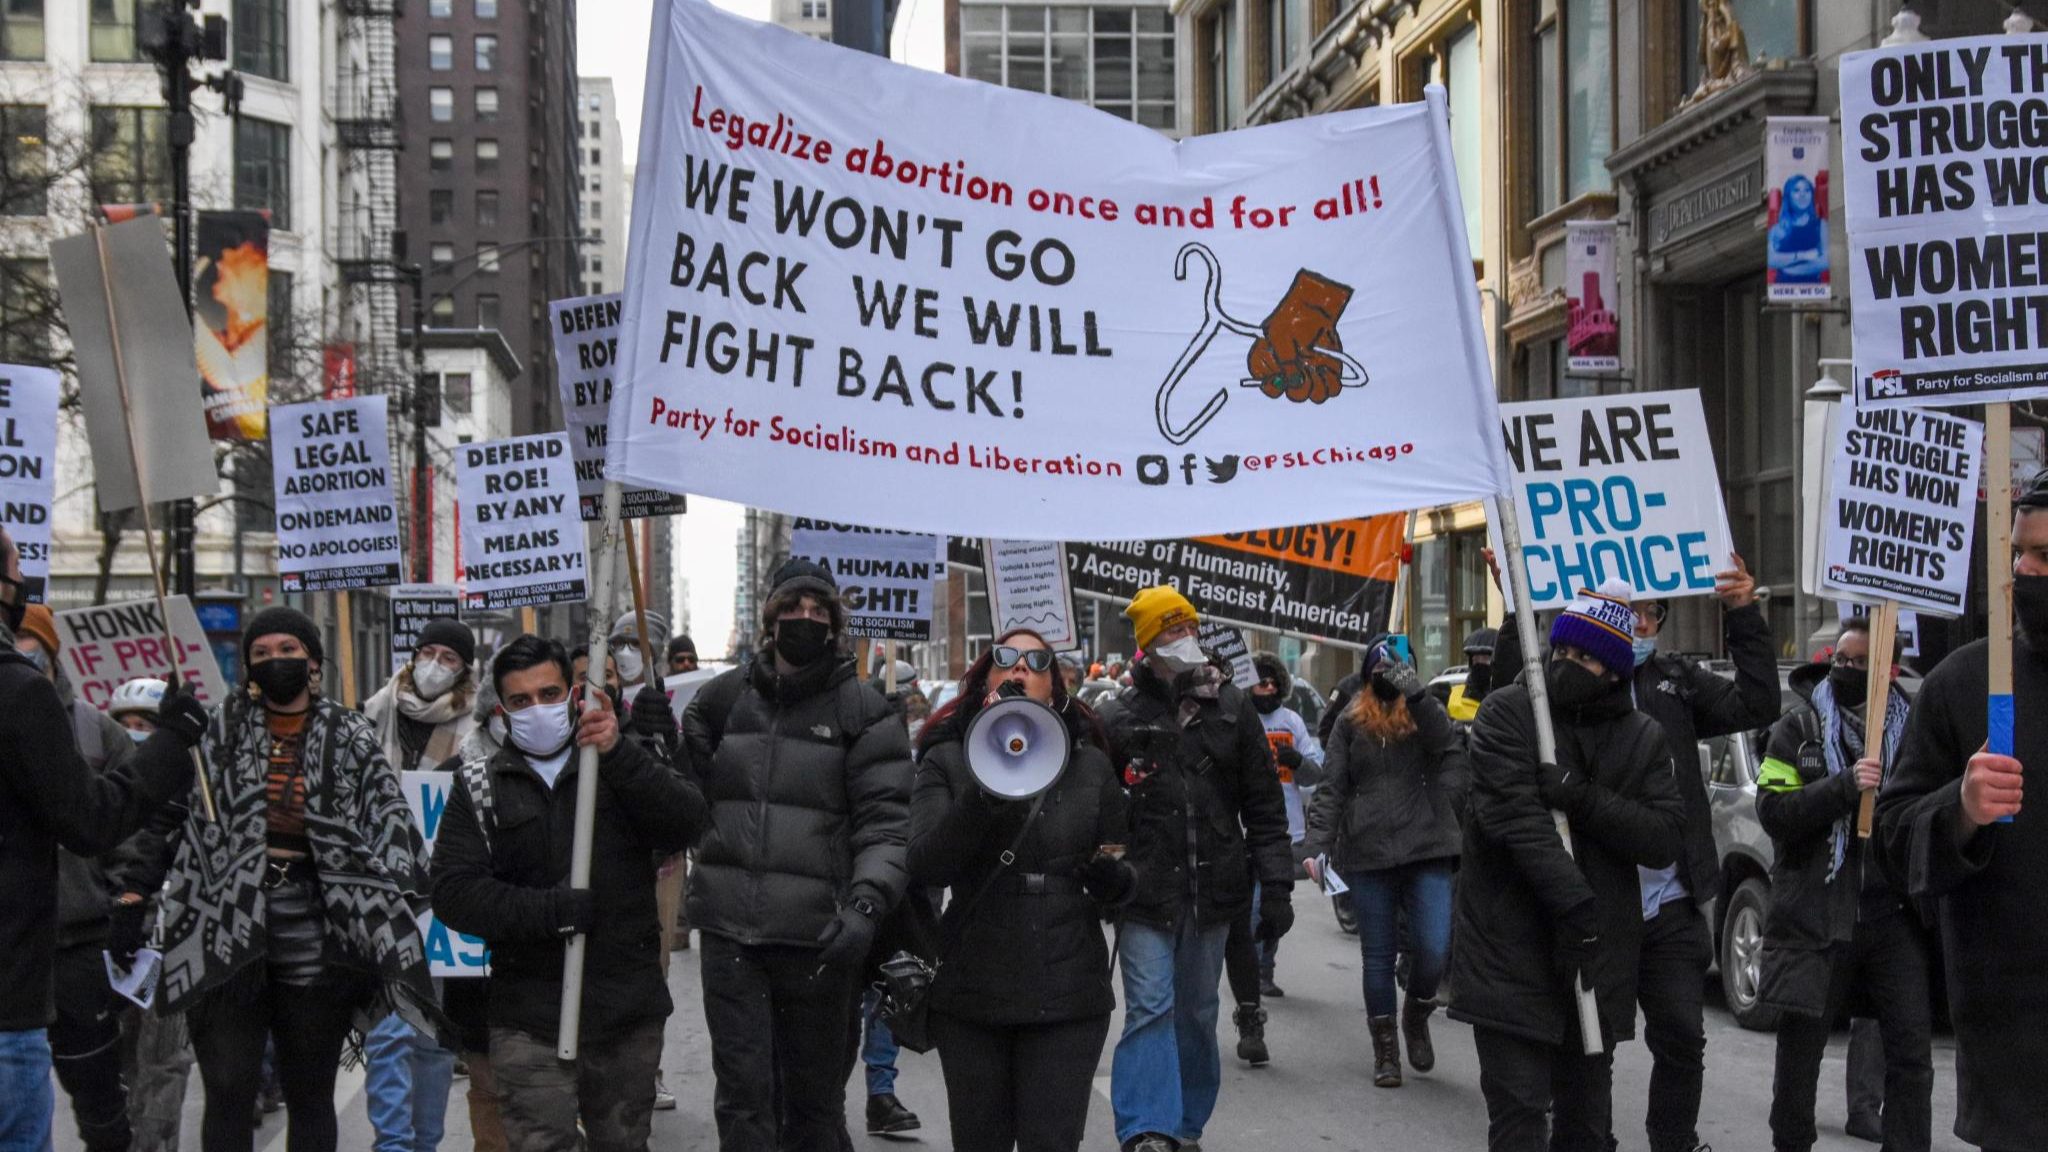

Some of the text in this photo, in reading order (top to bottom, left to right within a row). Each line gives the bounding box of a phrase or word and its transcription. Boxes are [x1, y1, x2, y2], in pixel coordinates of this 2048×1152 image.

[1870, 44, 2048, 107] ONLY TH
[1859, 98, 2048, 163] STRUGG
[691, 85, 1383, 229] Legalize abortion once and for all!
[1876, 154, 2048, 219] HAS WO
[685, 153, 1076, 286] WE WON'T GO
[1864, 231, 2048, 300] WOME
[669, 231, 1113, 358] BACK WE WILL
[559, 299, 622, 335] DEFEN
[1900, 295, 2048, 361] RIGHT
[659, 310, 1025, 419] FIGHT BACK!
[574, 379, 598, 407] BY
[1871, 375, 1908, 398] PSL
[1916, 370, 2048, 391] Party for Socialism an
[301, 408, 360, 439] SAFE
[650, 396, 1123, 478] Party for Socialism and Liberation
[1578, 403, 1680, 468] ARE
[1855, 408, 1967, 450] ONLY THE
[294, 439, 372, 470] LEGAL
[467, 438, 563, 469] DEFEND
[1242, 442, 1415, 471] @PSLChicago
[1845, 429, 1971, 480] STRUGGLE
[284, 466, 386, 496] ABORTION
[485, 467, 549, 495] ROE!
[1849, 460, 1900, 494] HAS
[1905, 470, 1960, 508] WON
[280, 504, 393, 531] ON DEMAND
[476, 494, 565, 523] BY ANY
[1525, 475, 1667, 540] PRO-
[1838, 498, 1965, 552] WOMEN'S
[279, 534, 399, 559] NO APOLOGIES!
[483, 528, 560, 555] MEANS
[1223, 521, 1357, 567] LOGY!
[304, 570, 328, 581] PARTY
[328, 568, 344, 579] FOR
[344, 565, 387, 578] SOCIALISM
[464, 552, 583, 582] NECESSARY!
[837, 557, 930, 580] HUMAN
[1152, 541, 1178, 564] of
[1180, 544, 1291, 592] Humanity,
[1521, 531, 1716, 602] CHOICE
[1848, 535, 1946, 582] RIGHTS
[305, 581, 322, 592] AND
[322, 578, 366, 590] LIBERATION
[488, 590, 513, 600] PARTY
[514, 588, 529, 598] FOR
[531, 582, 572, 595] SOCIALISM
[841, 585, 919, 614] GHT!
[1082, 552, 1162, 590] Accept
[1168, 574, 1180, 592] a
[1187, 574, 1267, 612] Fascist
[1270, 593, 1370, 633] America!
[1852, 575, 1871, 586] Party
[1872, 577, 1882, 586] for
[1882, 580, 1912, 594] Socialism
[1912, 587, 1924, 597] and
[1925, 588, 1956, 602] Liberation
[394, 600, 456, 616] Get Your Laws
[488, 599, 506, 609] AND
[506, 595, 550, 608] LIBERATION
[1601, 600, 1631, 622] MHS
[65, 603, 165, 643] HONK
[848, 616, 915, 630] OR SOCIALISM
[848, 627, 888, 638] ERATION
[1586, 605, 1632, 634] SAGES
[70, 634, 201, 677] IF PRO-
